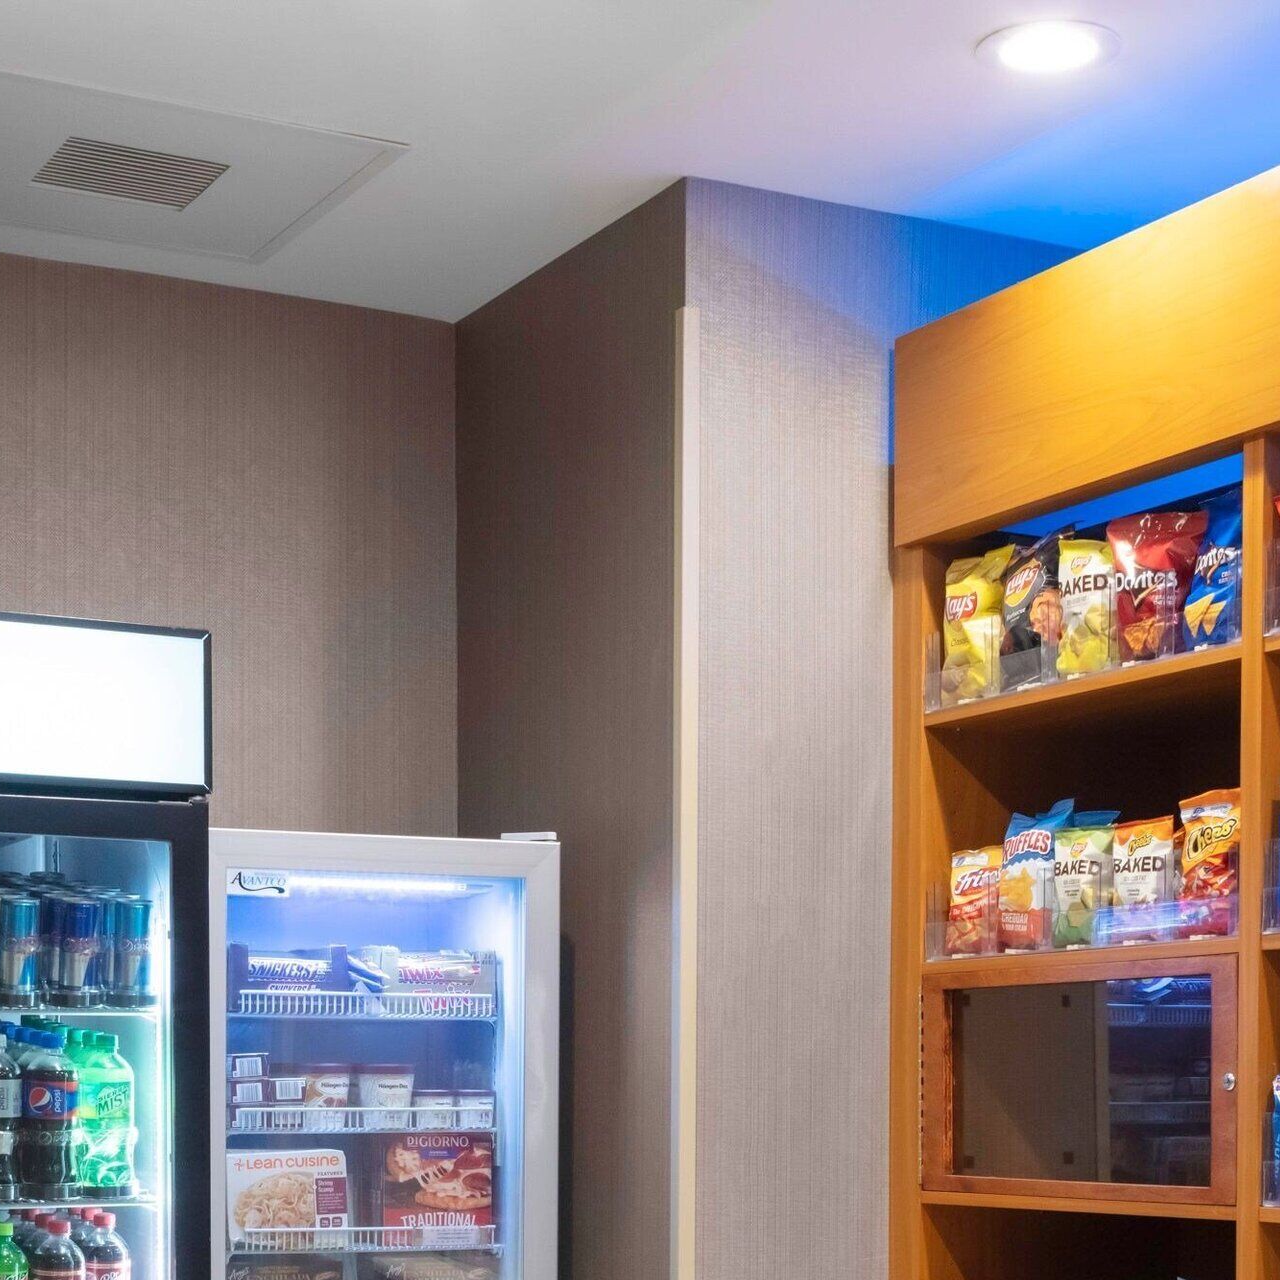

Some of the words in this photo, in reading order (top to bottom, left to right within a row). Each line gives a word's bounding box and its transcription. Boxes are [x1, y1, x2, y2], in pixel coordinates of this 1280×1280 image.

[1059, 575, 1108, 598] BAKED
[1115, 570, 1178, 591] Doritos
[946, 594, 976, 620] Lay's
[1054, 861, 1101, 876] BAKED
[1114, 856, 1165, 873] BAKED
[249, 962, 310, 976] SNICKERS
[407, 1136, 470, 1148] DIGIORNO
[247, 1158, 283, 1170] Lean
[285, 1155, 339, 1168] cuisine
[402, 1212, 477, 1228] TRADITIONAL
